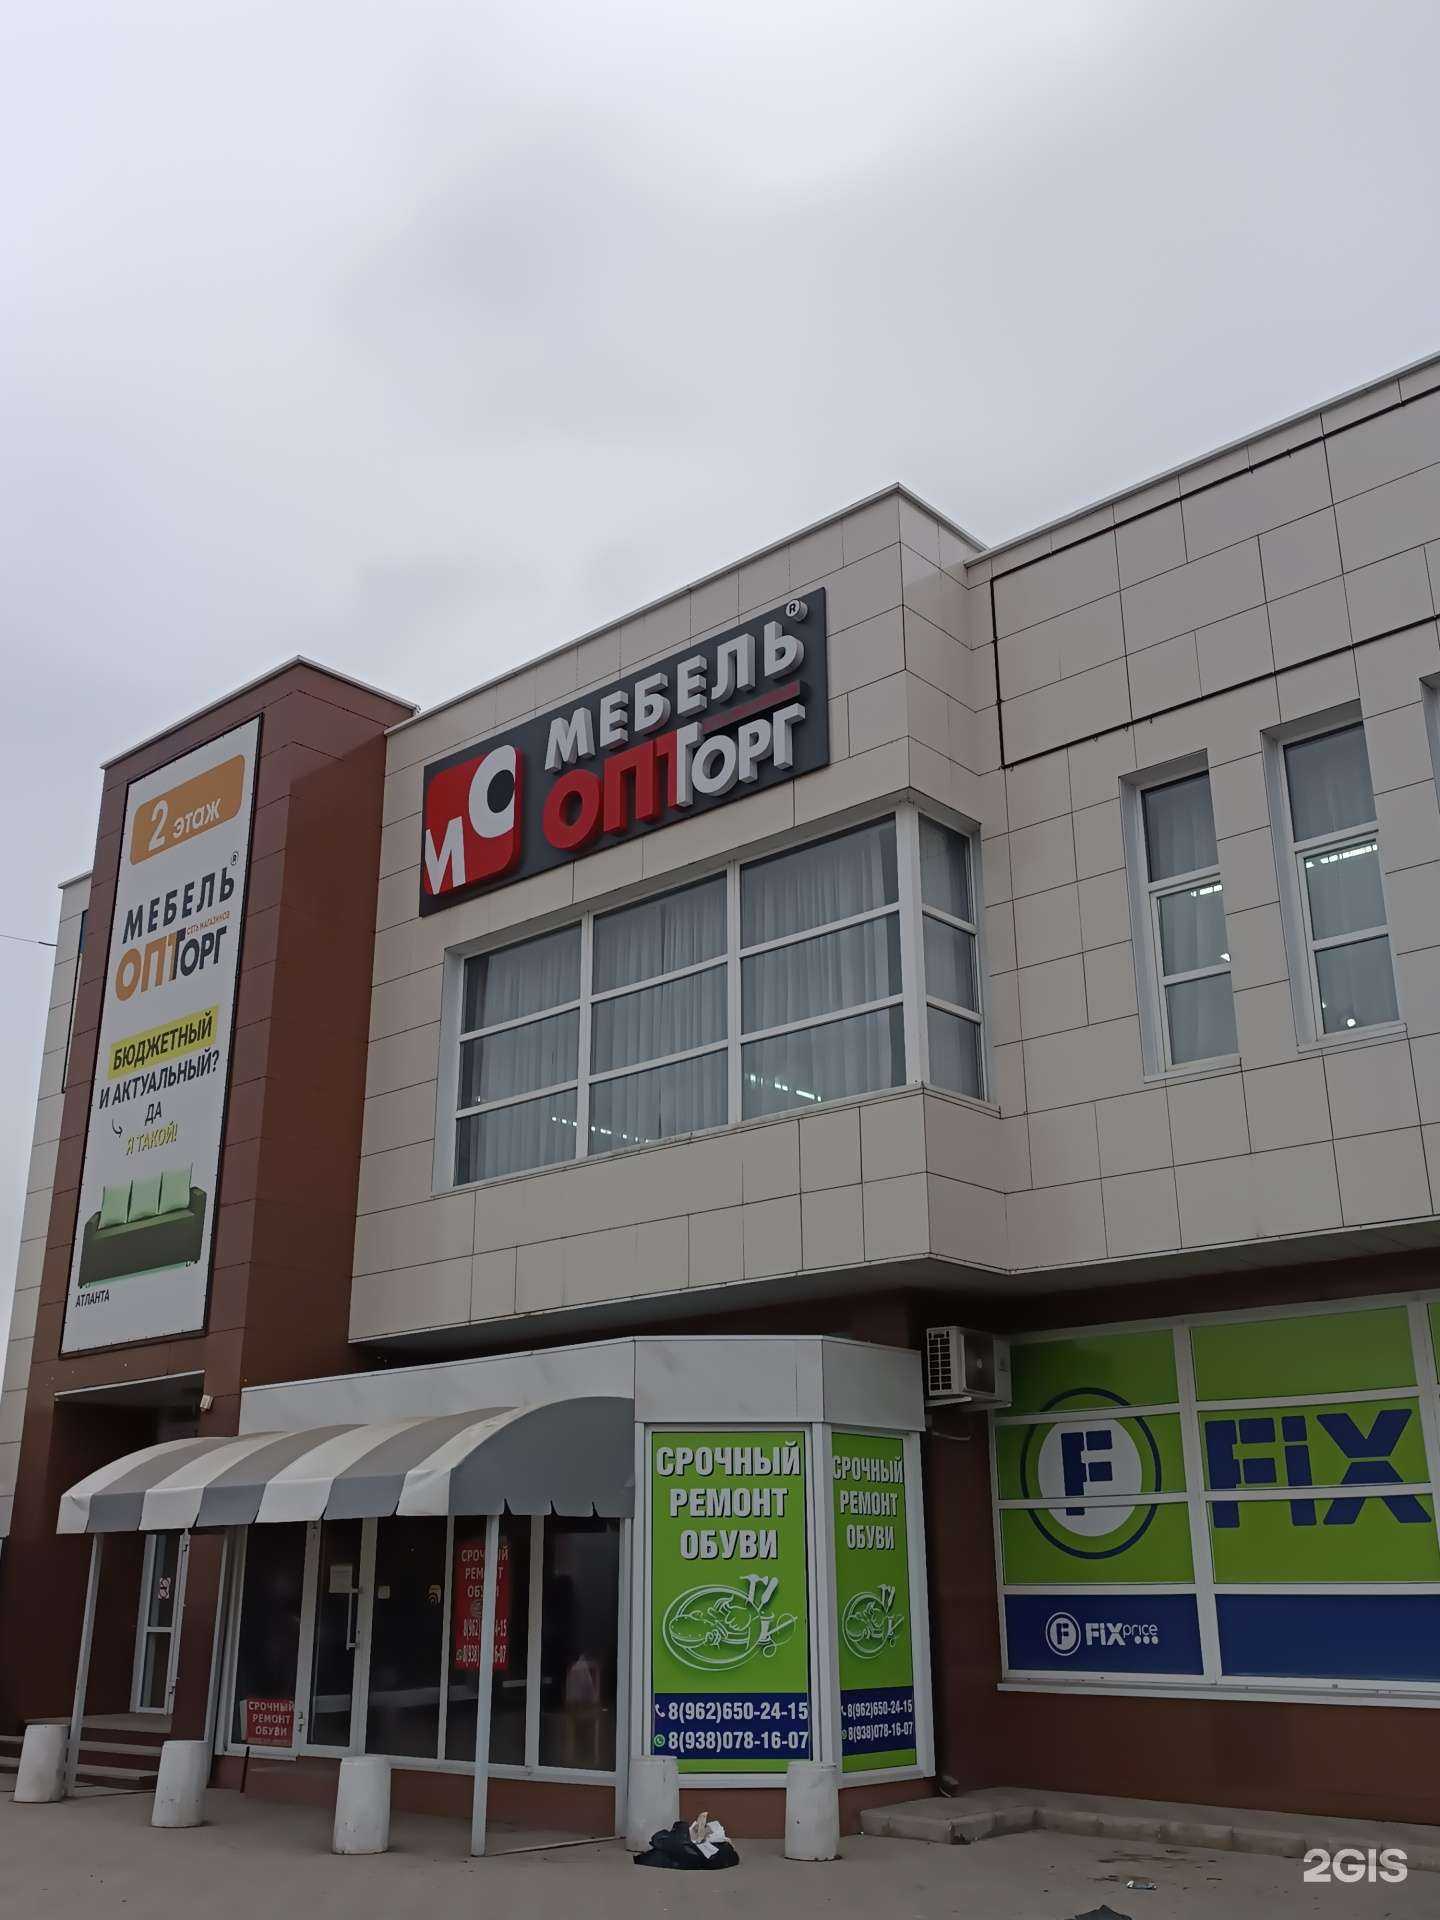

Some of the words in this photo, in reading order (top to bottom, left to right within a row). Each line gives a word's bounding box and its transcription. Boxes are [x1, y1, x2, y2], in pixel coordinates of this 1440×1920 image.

[545, 620, 805, 773] МЕБЕЛЬ
[147, 800, 170, 852] 2
[172, 798, 222, 839] этаж
[122, 867, 235, 945] МЕБЕЛЬ
[113, 1011, 213, 1071] БЮДЖЕТНЫЙ
[99, 1086, 111, 1110] И
[111, 1047, 220, 1106] АКТУАЛЬНЫЙ?
[144, 1101, 162, 1126] ДА
[126, 1136, 136, 1156] Я
[136, 1121, 178, 1153] ТАКОЙ!
[75, 1289, 111, 1308] АТЛАНТА
[656, 1441, 801, 1478] СРОЧНЫЙ
[833, 1455, 904, 1484] СРОЧНЫЙ
[669, 1487, 789, 1519] РЕМОНТ
[840, 1490, 898, 1517] РЕМОНТ
[680, 1529, 779, 1561] ОБУВИ
[846, 1524, 896, 1551] ОБУВИ
[252, 1713, 291, 1725] РЕМОНТ
[668, 1702, 808, 1723] 8(962)650-24-15
[255, 1725, 288, 1737] ОБУВИ
[668, 1731, 808, 1752] 8(938)078-16-07
[848, 1721, 913, 1743] 8(938)078-16-07
